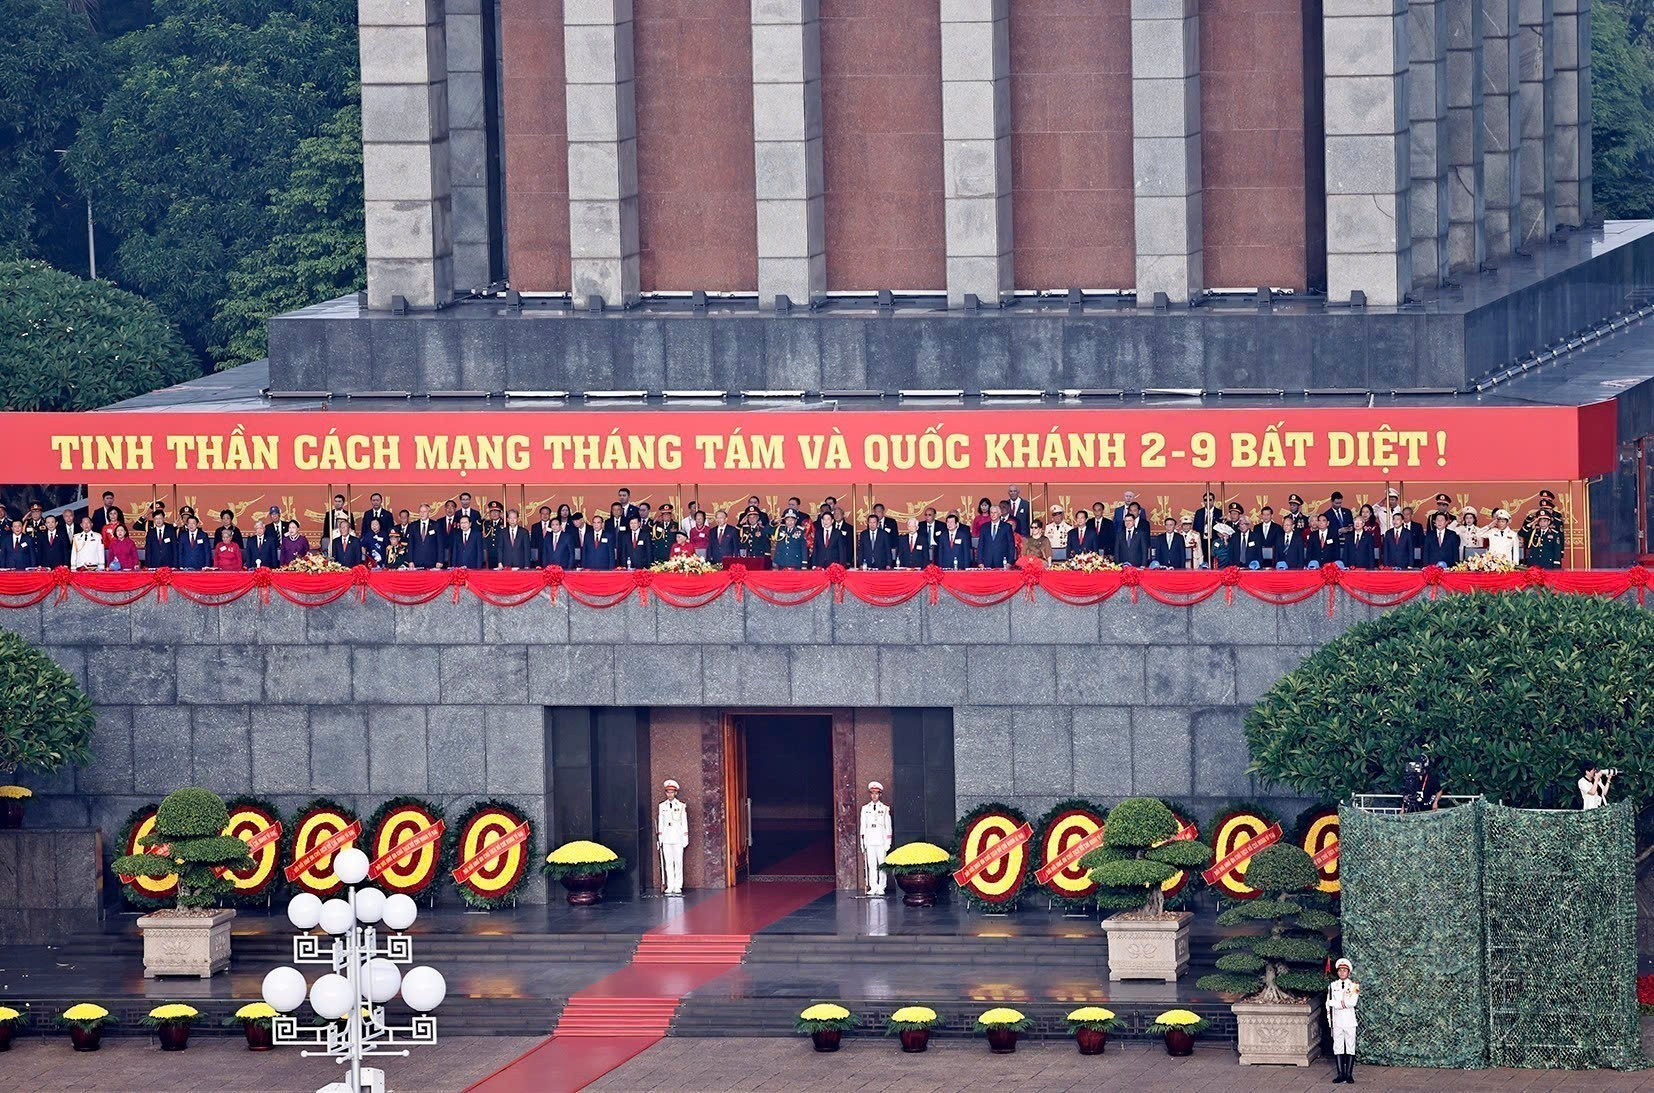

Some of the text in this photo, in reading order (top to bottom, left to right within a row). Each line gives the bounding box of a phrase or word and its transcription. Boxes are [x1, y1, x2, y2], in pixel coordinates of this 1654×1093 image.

[51, 435, 154, 471] TINH
[167, 423, 280, 471] THẦN
[293, 427, 401, 471] CÁCH
[413, 434, 530, 478] MẠNG
[544, 426, 683, 471] THÁNG
[694, 426, 786, 471] TÁM
[797, 426, 853, 471] VÀ
[863, 422, 971, 473] QUỐC
[983, 424, 1127, 470] KHÁNH
[1140, 431, 1217, 469] 2-9
[1230, 420, 1315, 469] BẤT
